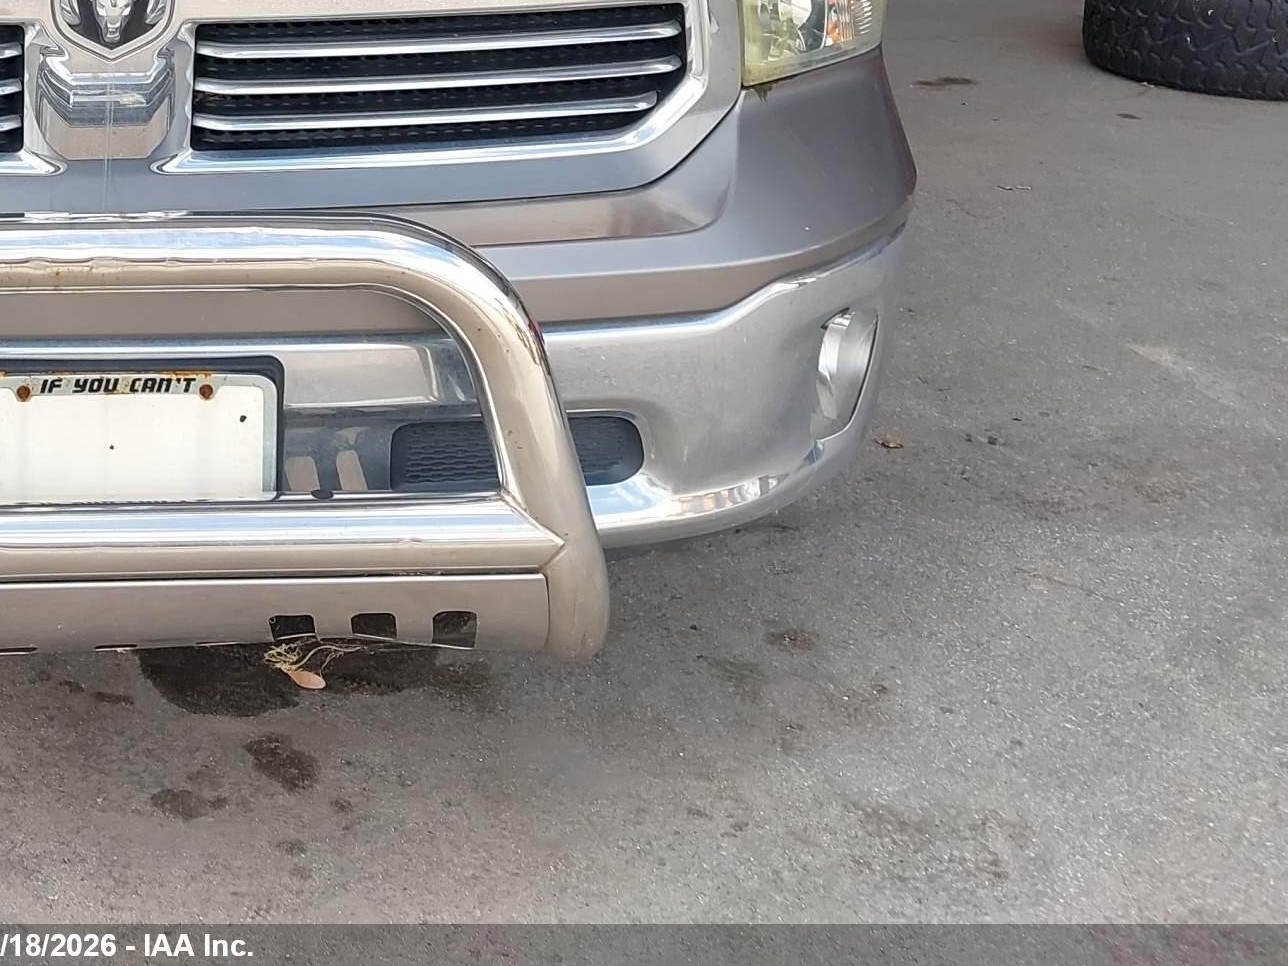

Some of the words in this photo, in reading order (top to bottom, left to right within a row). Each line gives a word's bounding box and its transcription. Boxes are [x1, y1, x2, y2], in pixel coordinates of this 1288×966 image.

[39, 378, 63, 393] IF
[72, 377, 119, 393] YOU
[129, 377, 196, 392] CAN'T
